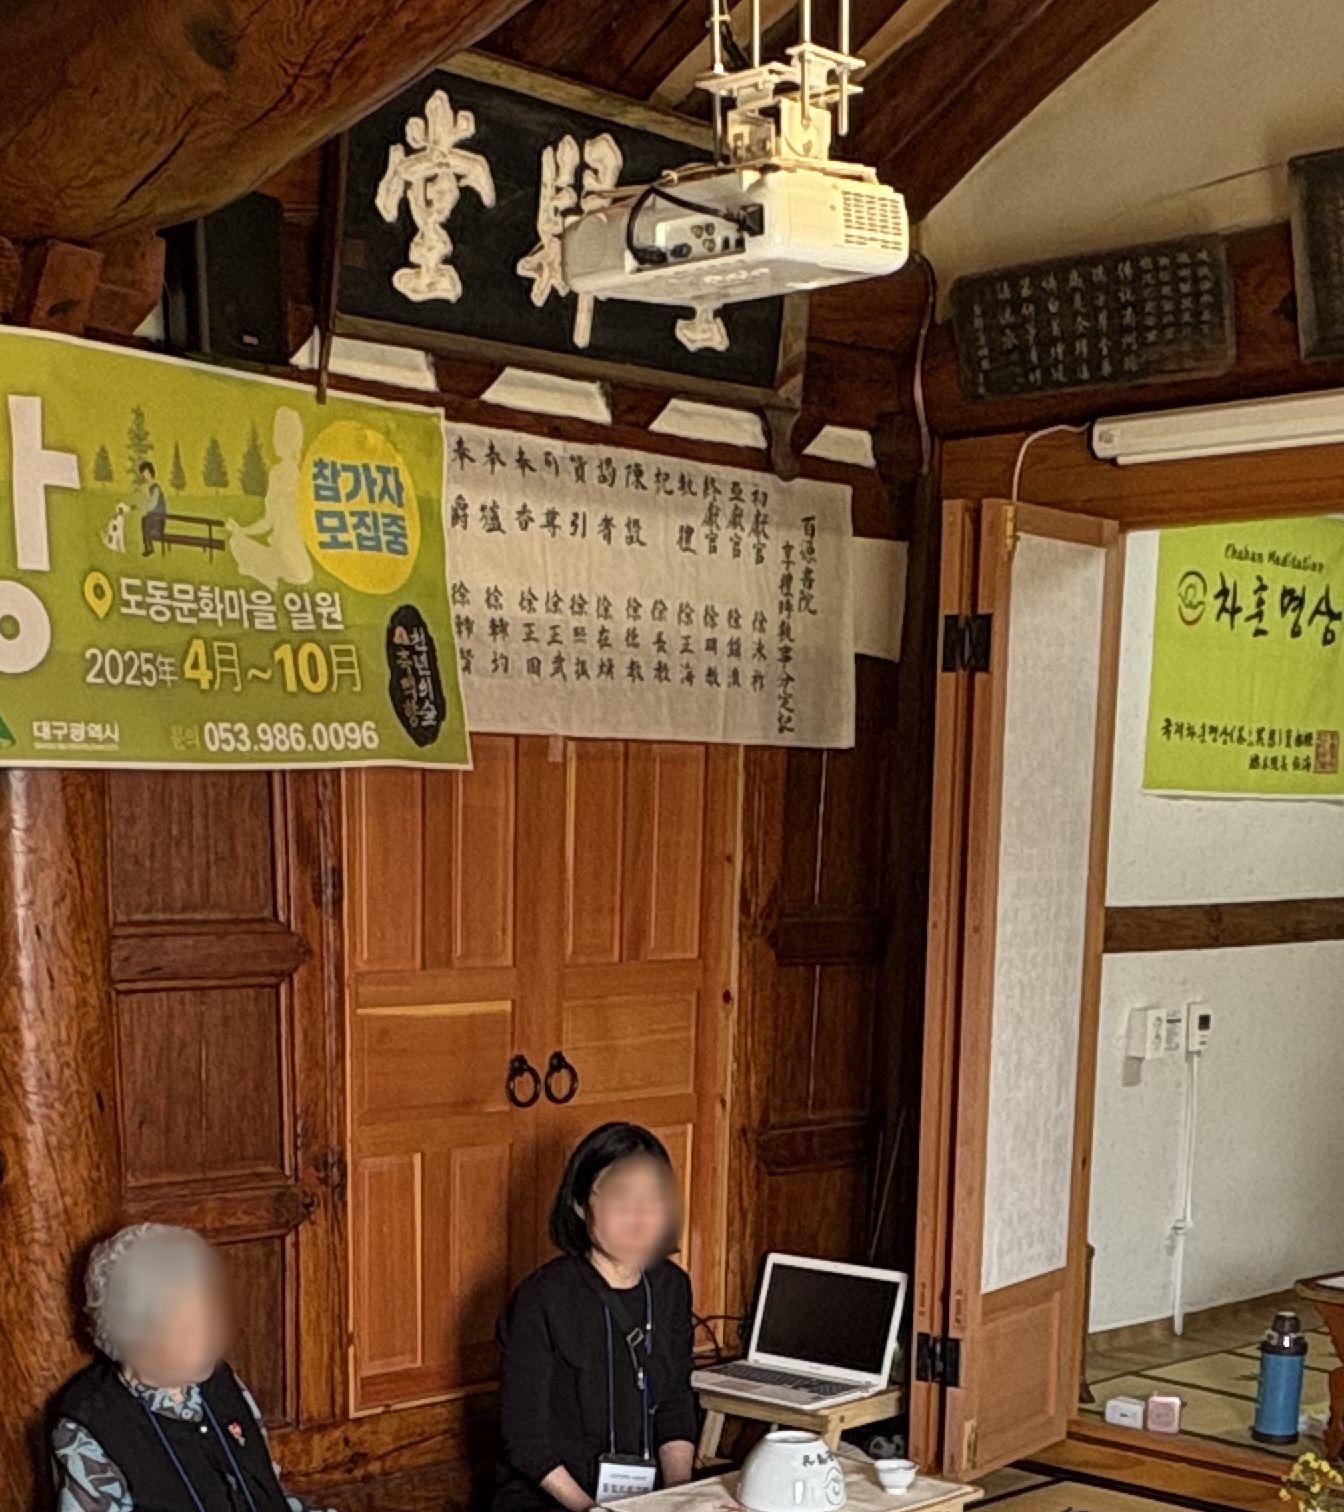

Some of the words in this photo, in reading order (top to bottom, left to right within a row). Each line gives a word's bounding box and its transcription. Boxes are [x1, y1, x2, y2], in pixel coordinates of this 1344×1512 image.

[312, 457, 405, 509] 참가자
[314, 508, 409, 556] 모집중
[119, 577, 278, 631] 도동문화마을
[283, 591, 345, 631] 일원
[84, 647, 181, 687] 2025年
[32, 720, 120, 743] 대구광역시
[203, 720, 380, 752] 053.986.0096
